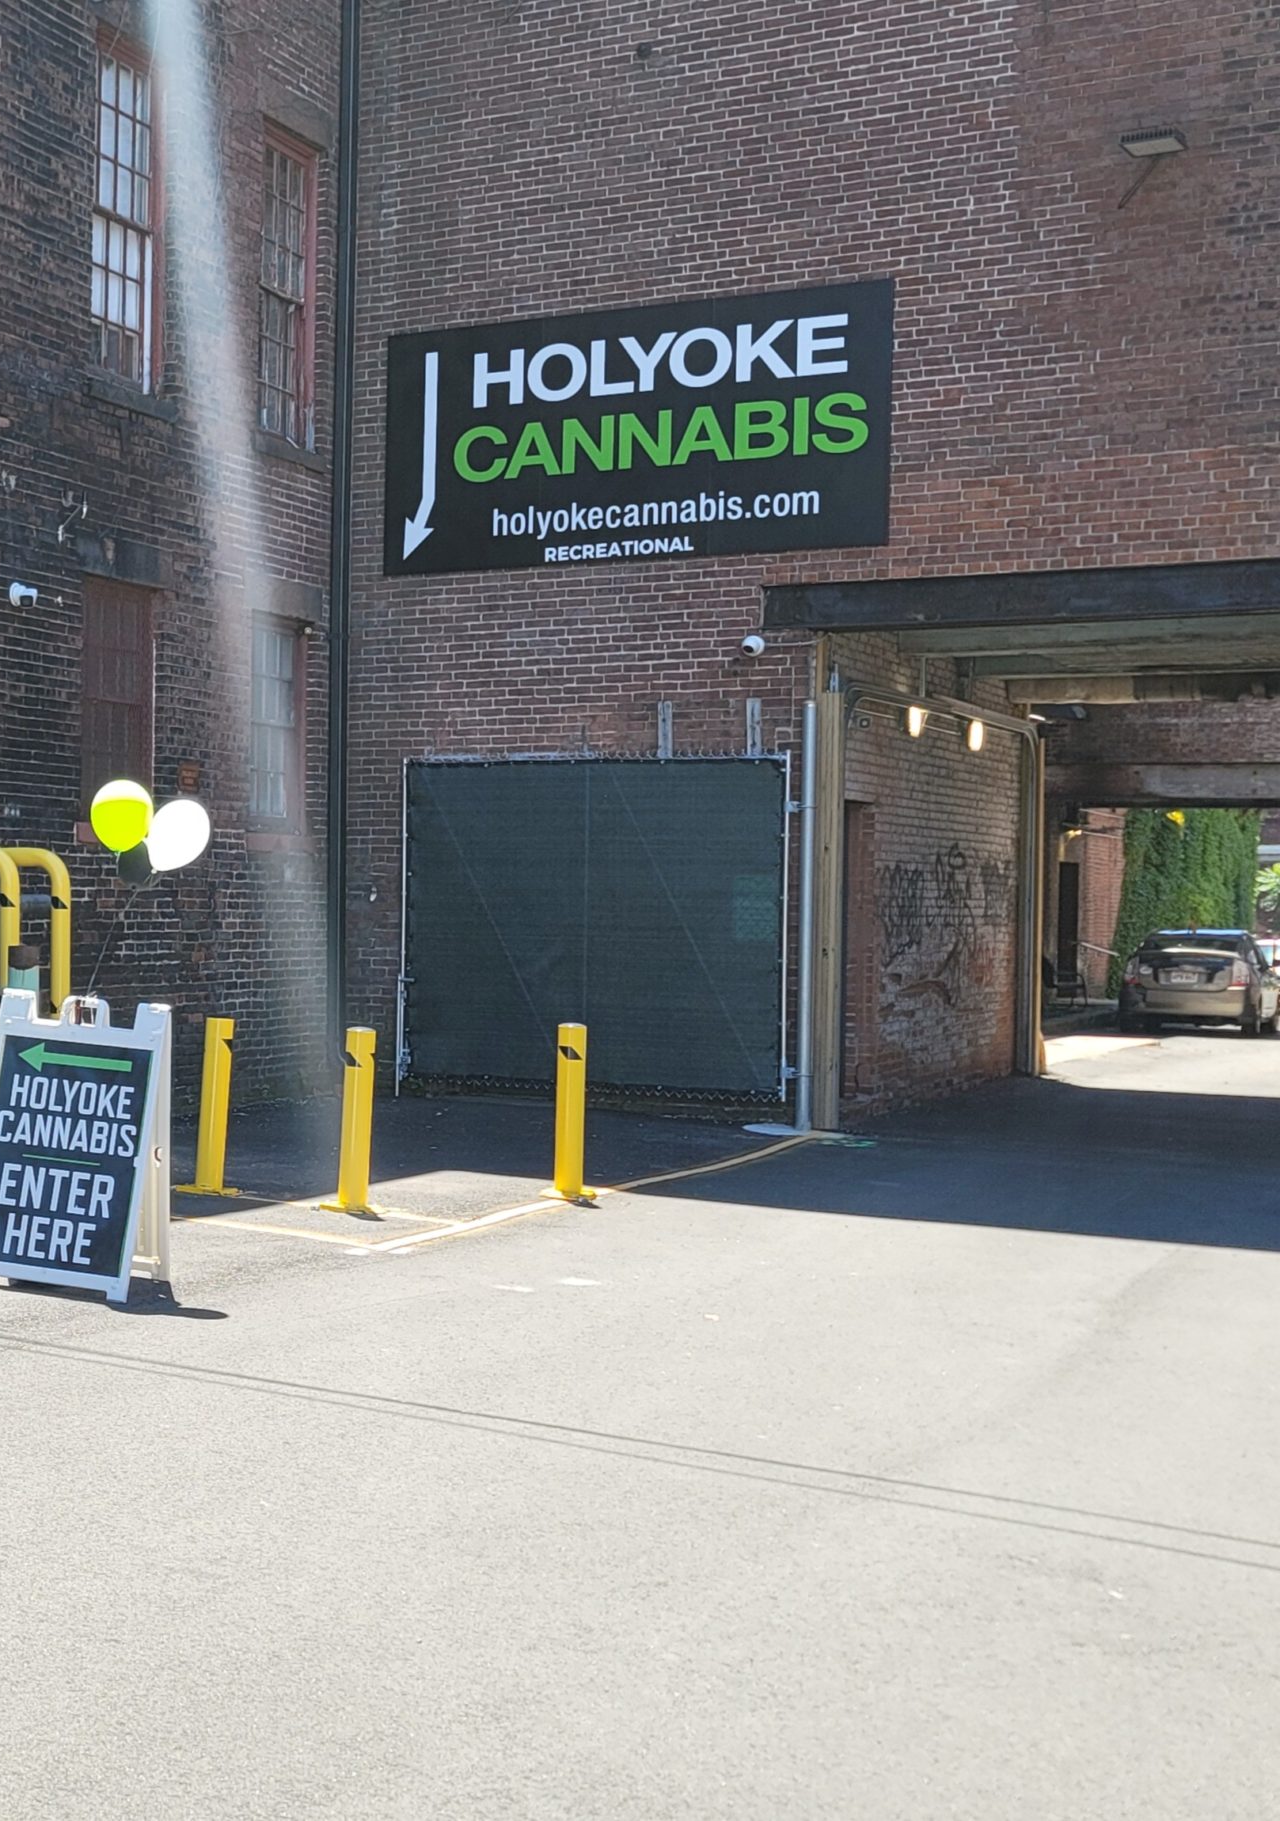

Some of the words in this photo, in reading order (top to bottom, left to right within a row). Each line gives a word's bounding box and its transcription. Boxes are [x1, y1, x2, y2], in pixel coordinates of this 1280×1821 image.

[472, 313, 849, 409] HOLYOKE
[453, 392, 869, 483] CANNABIS
[492, 490, 820, 540] holyokecannabis.com
[544, 536, 694, 562] RECREATIONAL
[9, 1073, 135, 1120] HOLYOKE
[2, 1212, 97, 1266] HERE
